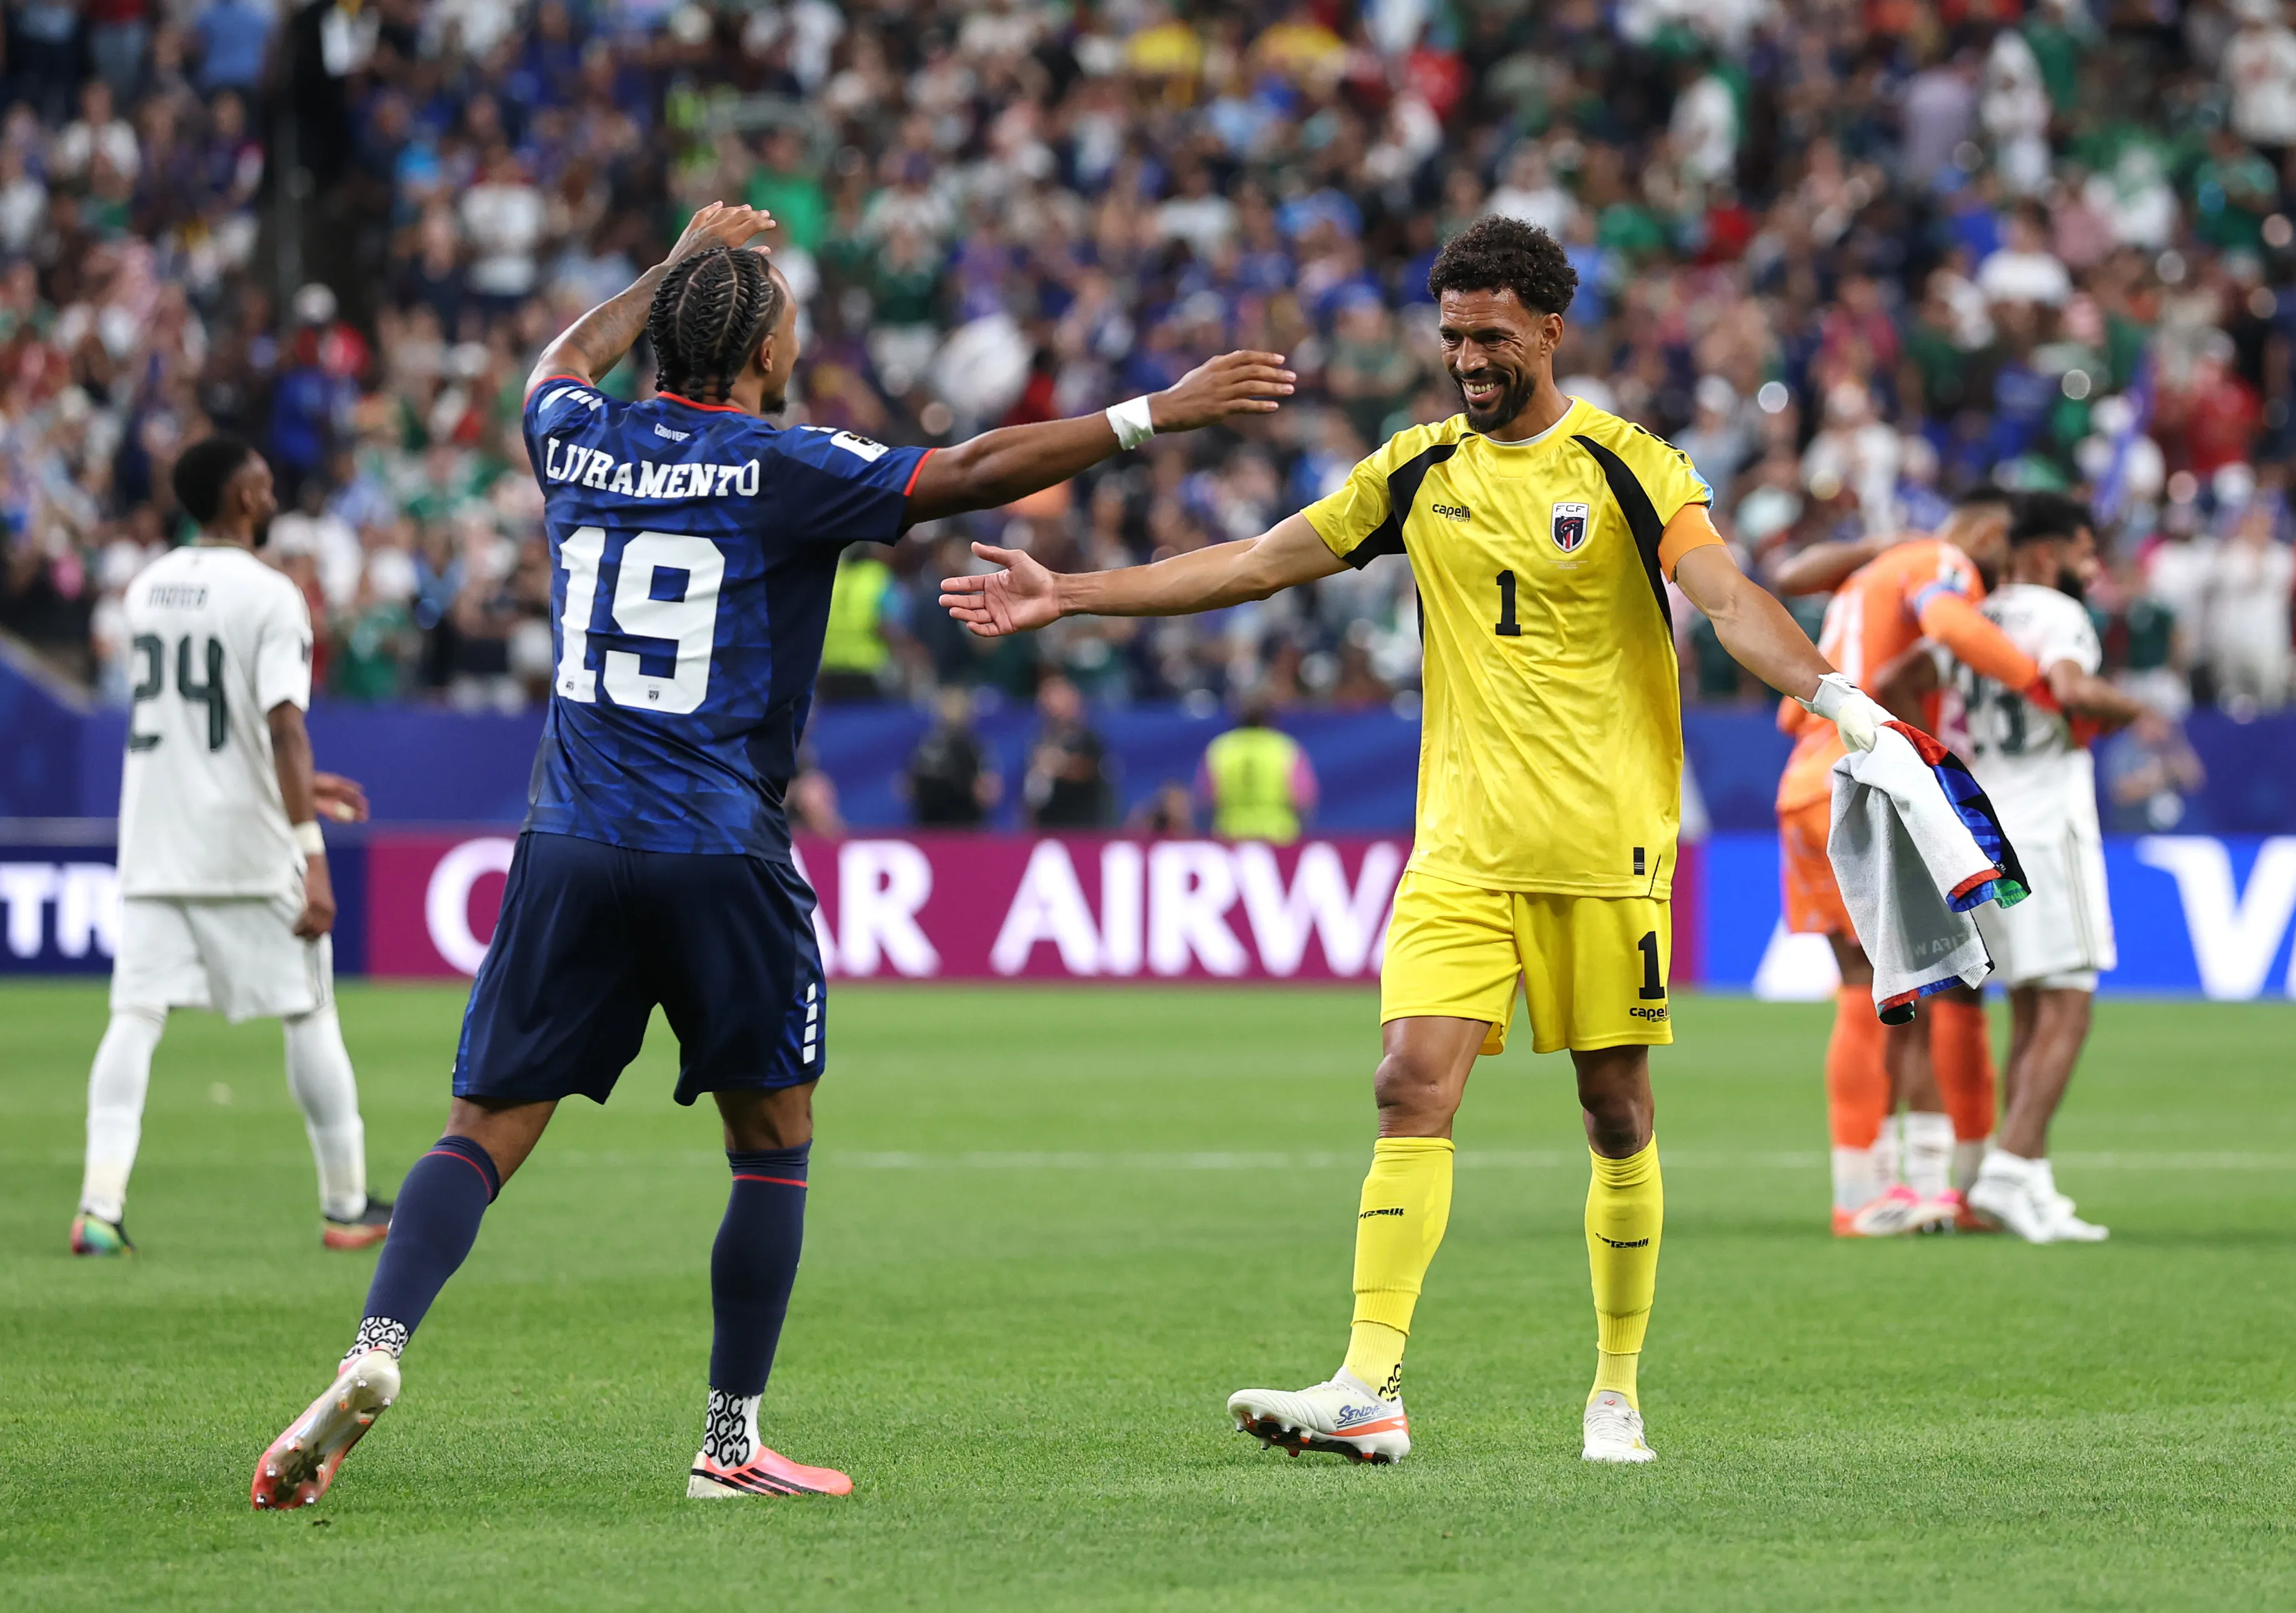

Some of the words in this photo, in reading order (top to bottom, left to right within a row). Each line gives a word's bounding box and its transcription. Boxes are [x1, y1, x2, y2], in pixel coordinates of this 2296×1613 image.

[546, 437, 760, 498] LIVRAMENTO
[1432, 503, 1471, 518] capelli
[1555, 505, 1586, 513] FCF
[556, 526, 726, 715] 19
[1495, 569, 1521, 636] 1
[129, 633, 226, 753] 24
[989, 838, 1399, 977] AIRW
[2132, 834, 2296, 1002] V
[1638, 930, 1665, 1000] 1
